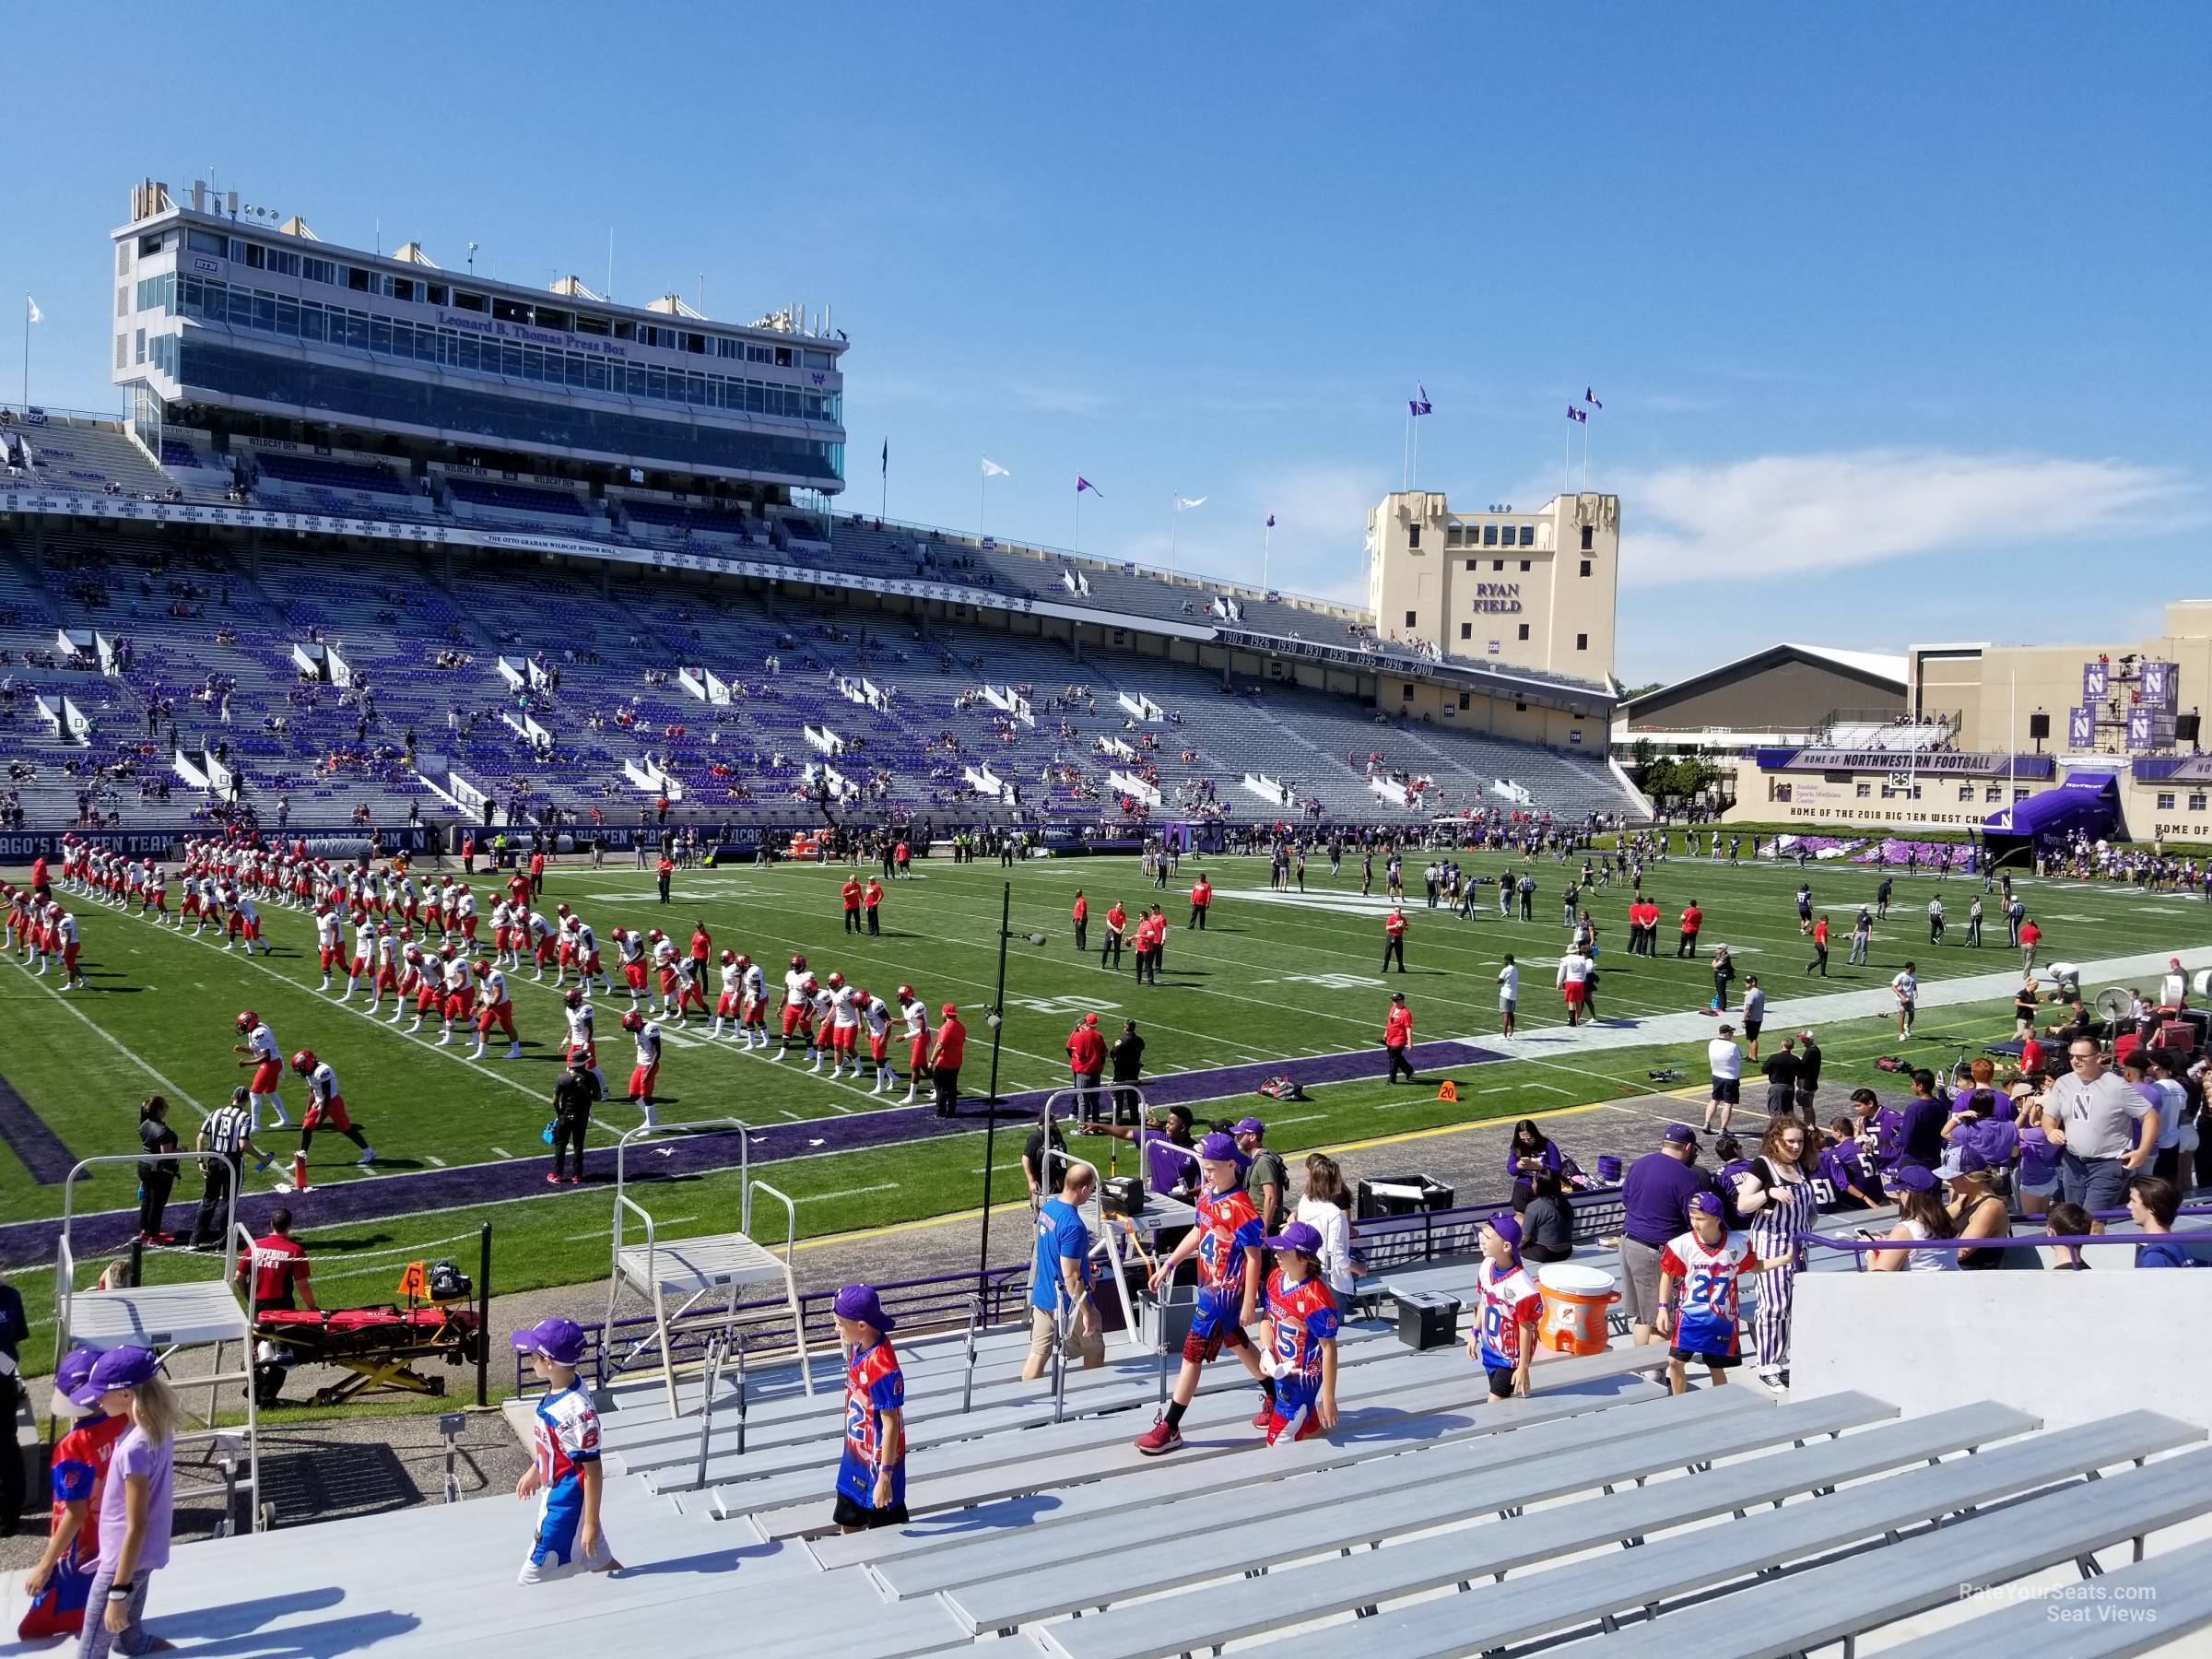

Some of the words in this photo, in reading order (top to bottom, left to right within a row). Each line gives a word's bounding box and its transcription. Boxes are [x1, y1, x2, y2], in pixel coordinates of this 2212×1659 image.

[195, 259, 217, 270] BTN
[439, 312, 491, 333] Leonard
[496, 324, 509, 335] B.
[512, 325, 562, 345] Thomas
[566, 335, 600, 352] Press
[603, 342, 626, 356] Box
[29, 413, 42, 422] 227
[250, 437, 283, 450] WILDCAT
[283, 442, 297, 451] DEN
[443, 464, 473, 475] WILDCAT
[474, 468, 487, 477] DEN
[534, 475, 561, 485] WILDCAT
[563, 477, 575, 488] DEN
[521, 538, 548, 547] GRAHAM
[549, 542, 577, 550] WILDCAT
[579, 546, 600, 554] HONOR
[1477, 583, 1520, 597] RYAN
[1473, 599, 1523, 614] FIELD
[1224, 630, 1243, 644] 1903
[1251, 634, 1270, 649] 1926
[1277, 639, 1298, 653] 1930
[1304, 643, 1322, 657] 1931
[1329, 648, 1348, 662] 1936
[1356, 653, 1376, 666] 1995
[1383, 657, 1404, 671] 1996
[1411, 662, 1434, 677] 2000
[2088, 673, 2102, 692] N
[2146, 673, 2160, 692] N
[2075, 717, 2088, 737] N
[2132, 719, 2147, 738] N
[1804, 755, 1827, 764] HOME
[1830, 756, 1841, 764] OF
[1843, 754, 1931, 770] NORTHWESTERN
[1935, 756, 1991, 770] FOOTBALL
[1892, 773, 1908, 786] 25
[1791, 807, 1816, 817] HOME
[1819, 809, 1831, 818] OF
[1835, 809, 1853, 818] THE
[1858, 810, 1880, 819] 2018
[1886, 812, 1902, 821] BIG
[1907, 813, 1927, 822] TEN
[1932, 814, 1961, 822] WEST
[2001, 813, 2012, 828] N
[605, 830, 628, 844] TEN
[2154, 824, 2189, 835] HOME
[2194, 826, 2209, 835] OF
[89, 836, 124, 853] TEN
[131, 835, 175, 853] TEAM
[413, 830, 424, 849] N
[1282, 973, 1387, 988] 30
[1003, 995, 1123, 1015] 20
[1441, 1087, 1453, 1099] 20
[2074, 1093, 2092, 1122] N
[1810, 1178, 1836, 1205] 51
[1199, 1231, 1218, 1267] 4
[407, 1267, 420, 1288] G
[1691, 1274, 1730, 1305] 27
